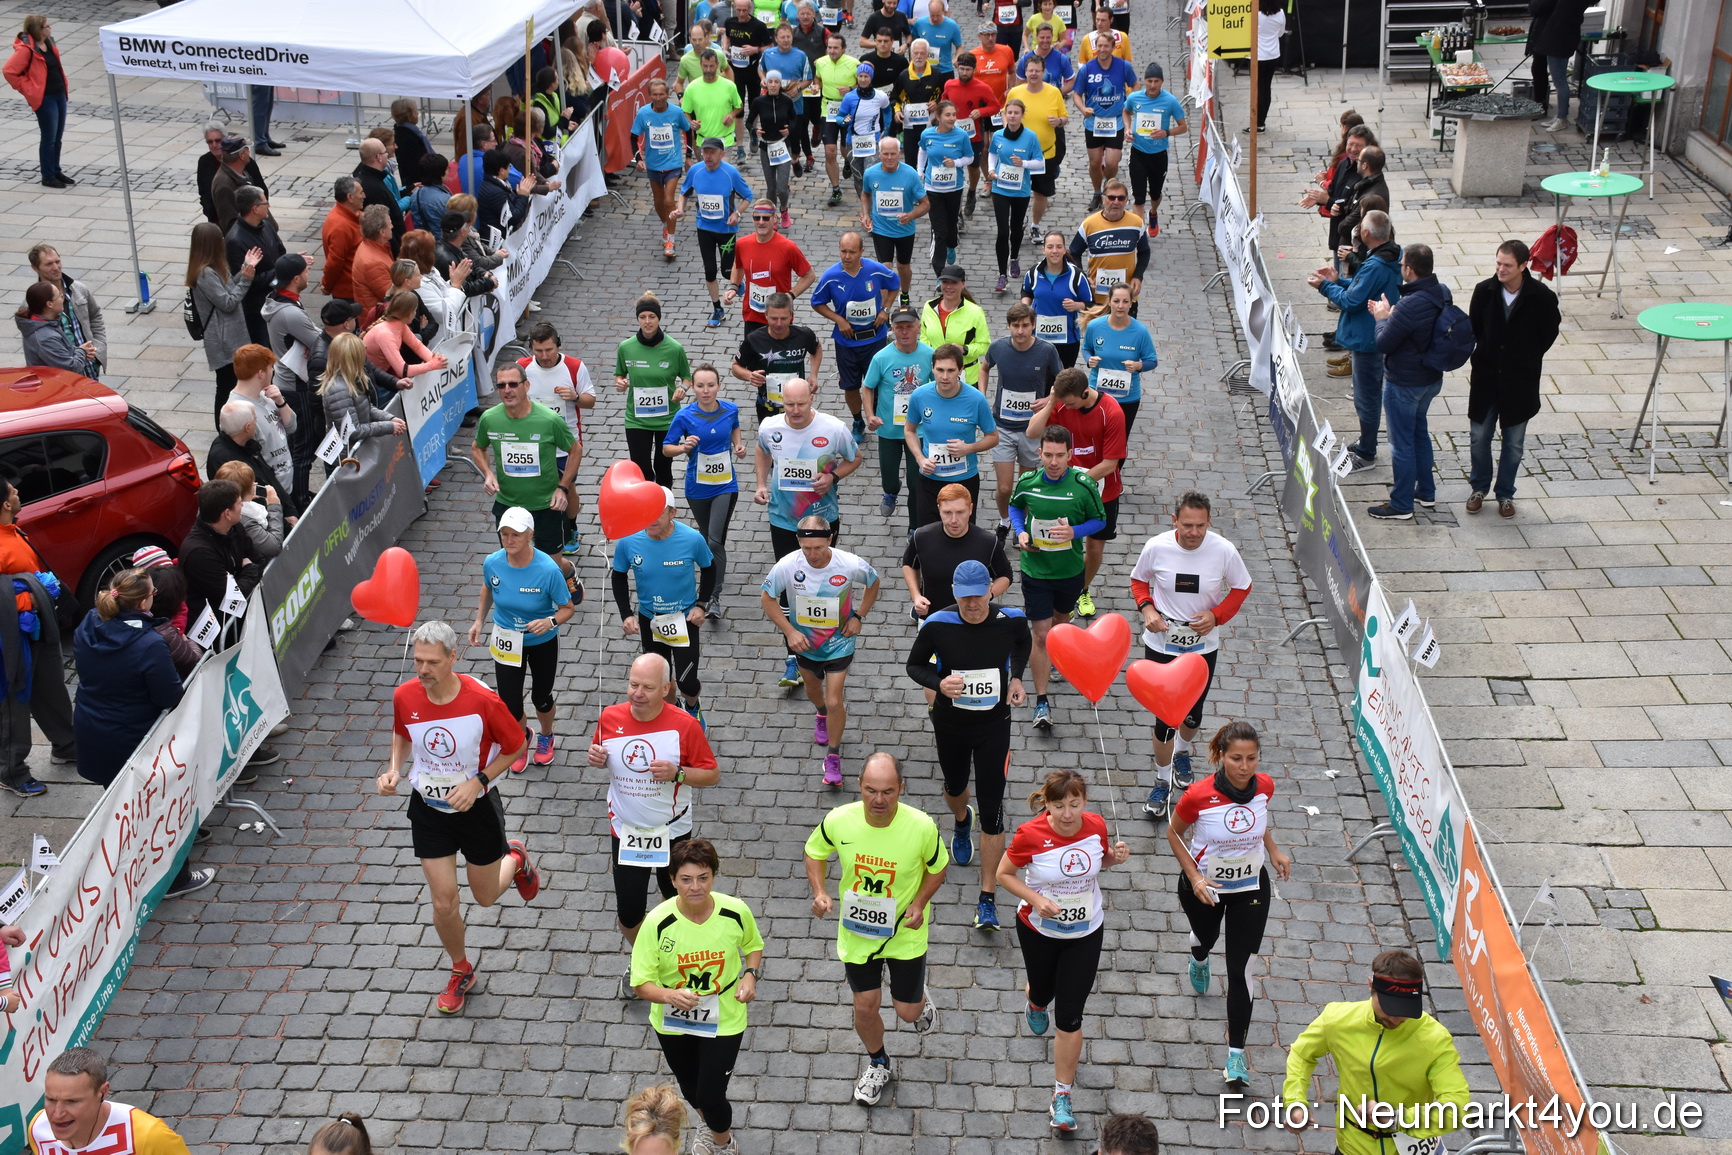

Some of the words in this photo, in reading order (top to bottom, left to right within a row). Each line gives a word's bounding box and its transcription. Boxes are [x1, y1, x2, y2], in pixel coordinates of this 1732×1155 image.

[1209, 3, 1252, 17] Jugend
[1222, 16, 1244, 29] lauf
[119, 36, 166, 54] BMW
[171, 40, 309, 65] ConnectedDrive
[121, 55, 177, 72] Vernetzt,
[179, 61, 198, 71] um
[199, 61, 220, 72] frei
[222, 64, 236, 74] zu
[239, 65, 267, 76] sein.
[1088, 73, 1103, 83] 28
[909, 109, 926, 117] 2212
[1096, 121, 1114, 129] 2383
[1141, 120, 1156, 128] 273
[652, 133, 670, 141] 2316
[855, 141, 873, 149] 2065
[934, 173, 953, 181] 2367
[1001, 171, 1020, 181] 2368
[702, 201, 720, 210] 2559
[880, 198, 900, 207] 2022
[1101, 236, 1131, 247] Fischer
[1100, 277, 1120, 286] 2121
[752, 292, 770, 303] 251
[850, 307, 871, 317] 2061
[1040, 323, 1063, 333] 2026
[785, 348, 806, 357] 2017
[1101, 378, 1126, 389] 2445
[639, 395, 664, 406] 2215
[1006, 399, 1031, 410] 2499
[323, 440, 336, 457] swn
[506, 453, 534, 464] 2555
[705, 463, 724, 474] 289
[783, 467, 812, 479] 2589
[271, 553, 323, 649] BOCK
[806, 606, 827, 617] 161
[197, 620, 213, 641] swn
[656, 623, 678, 636] 198
[495, 636, 513, 651] 199
[1171, 634, 1201, 646] 2437
[1421, 638, 1436, 661] swn
[961, 682, 993, 695] 2165
[627, 834, 662, 849] 2170
[855, 853, 897, 869] Müller
[1215, 864, 1253, 879] 2914
[863, 876, 884, 894] M
[0, 887, 24, 914] swn
[48, 852, 101, 958] UNS
[849, 905, 888, 925] 2598
[1050, 906, 1086, 922] 338
[854, 923, 880, 934] Wolfgang
[677, 949, 726, 965] Müller
[22, 887, 121, 1083] EINFACH
[686, 971, 712, 991] M
[670, 1004, 710, 1022] 2417
[1515, 1007, 1539, 1056] Neumarkts
